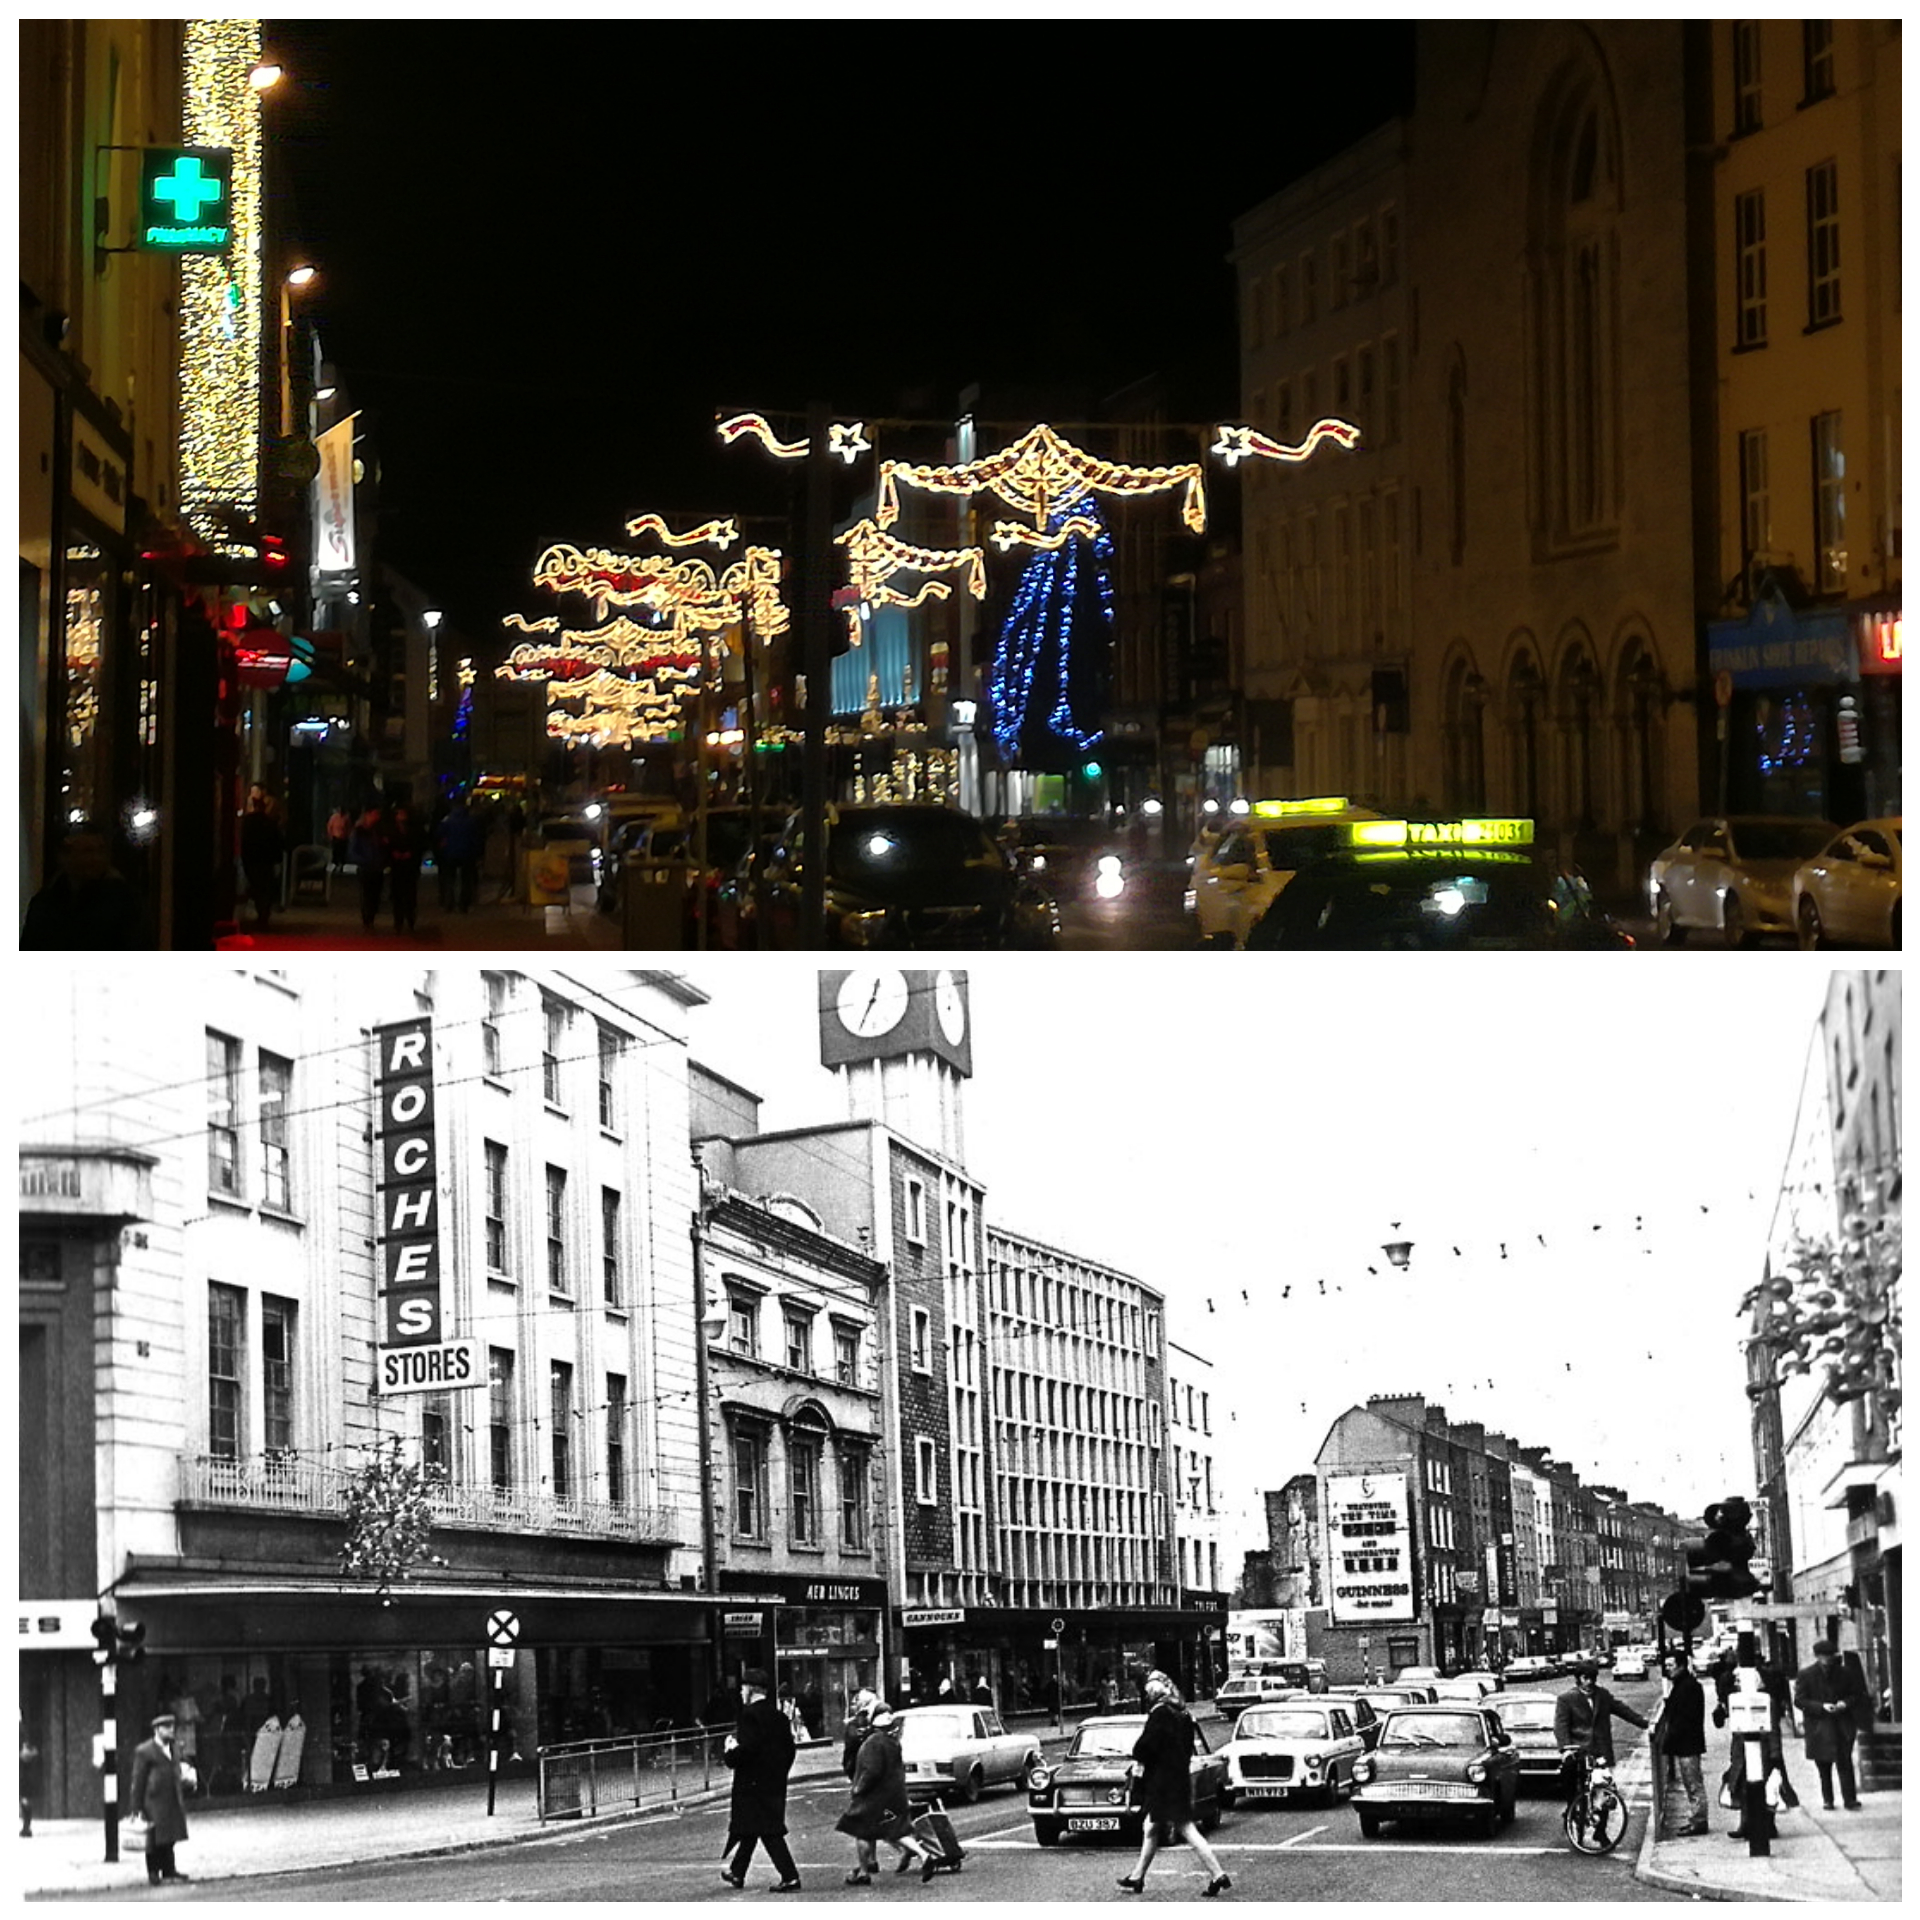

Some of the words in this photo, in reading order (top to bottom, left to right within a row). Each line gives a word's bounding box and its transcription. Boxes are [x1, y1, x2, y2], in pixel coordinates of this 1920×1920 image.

[1407, 823, 1461, 842] TAXI
[389, 1032, 433, 1336] ROCHES
[385, 1346, 470, 1386] STORES
[1336, 1583, 1409, 1598] GUINNESS
